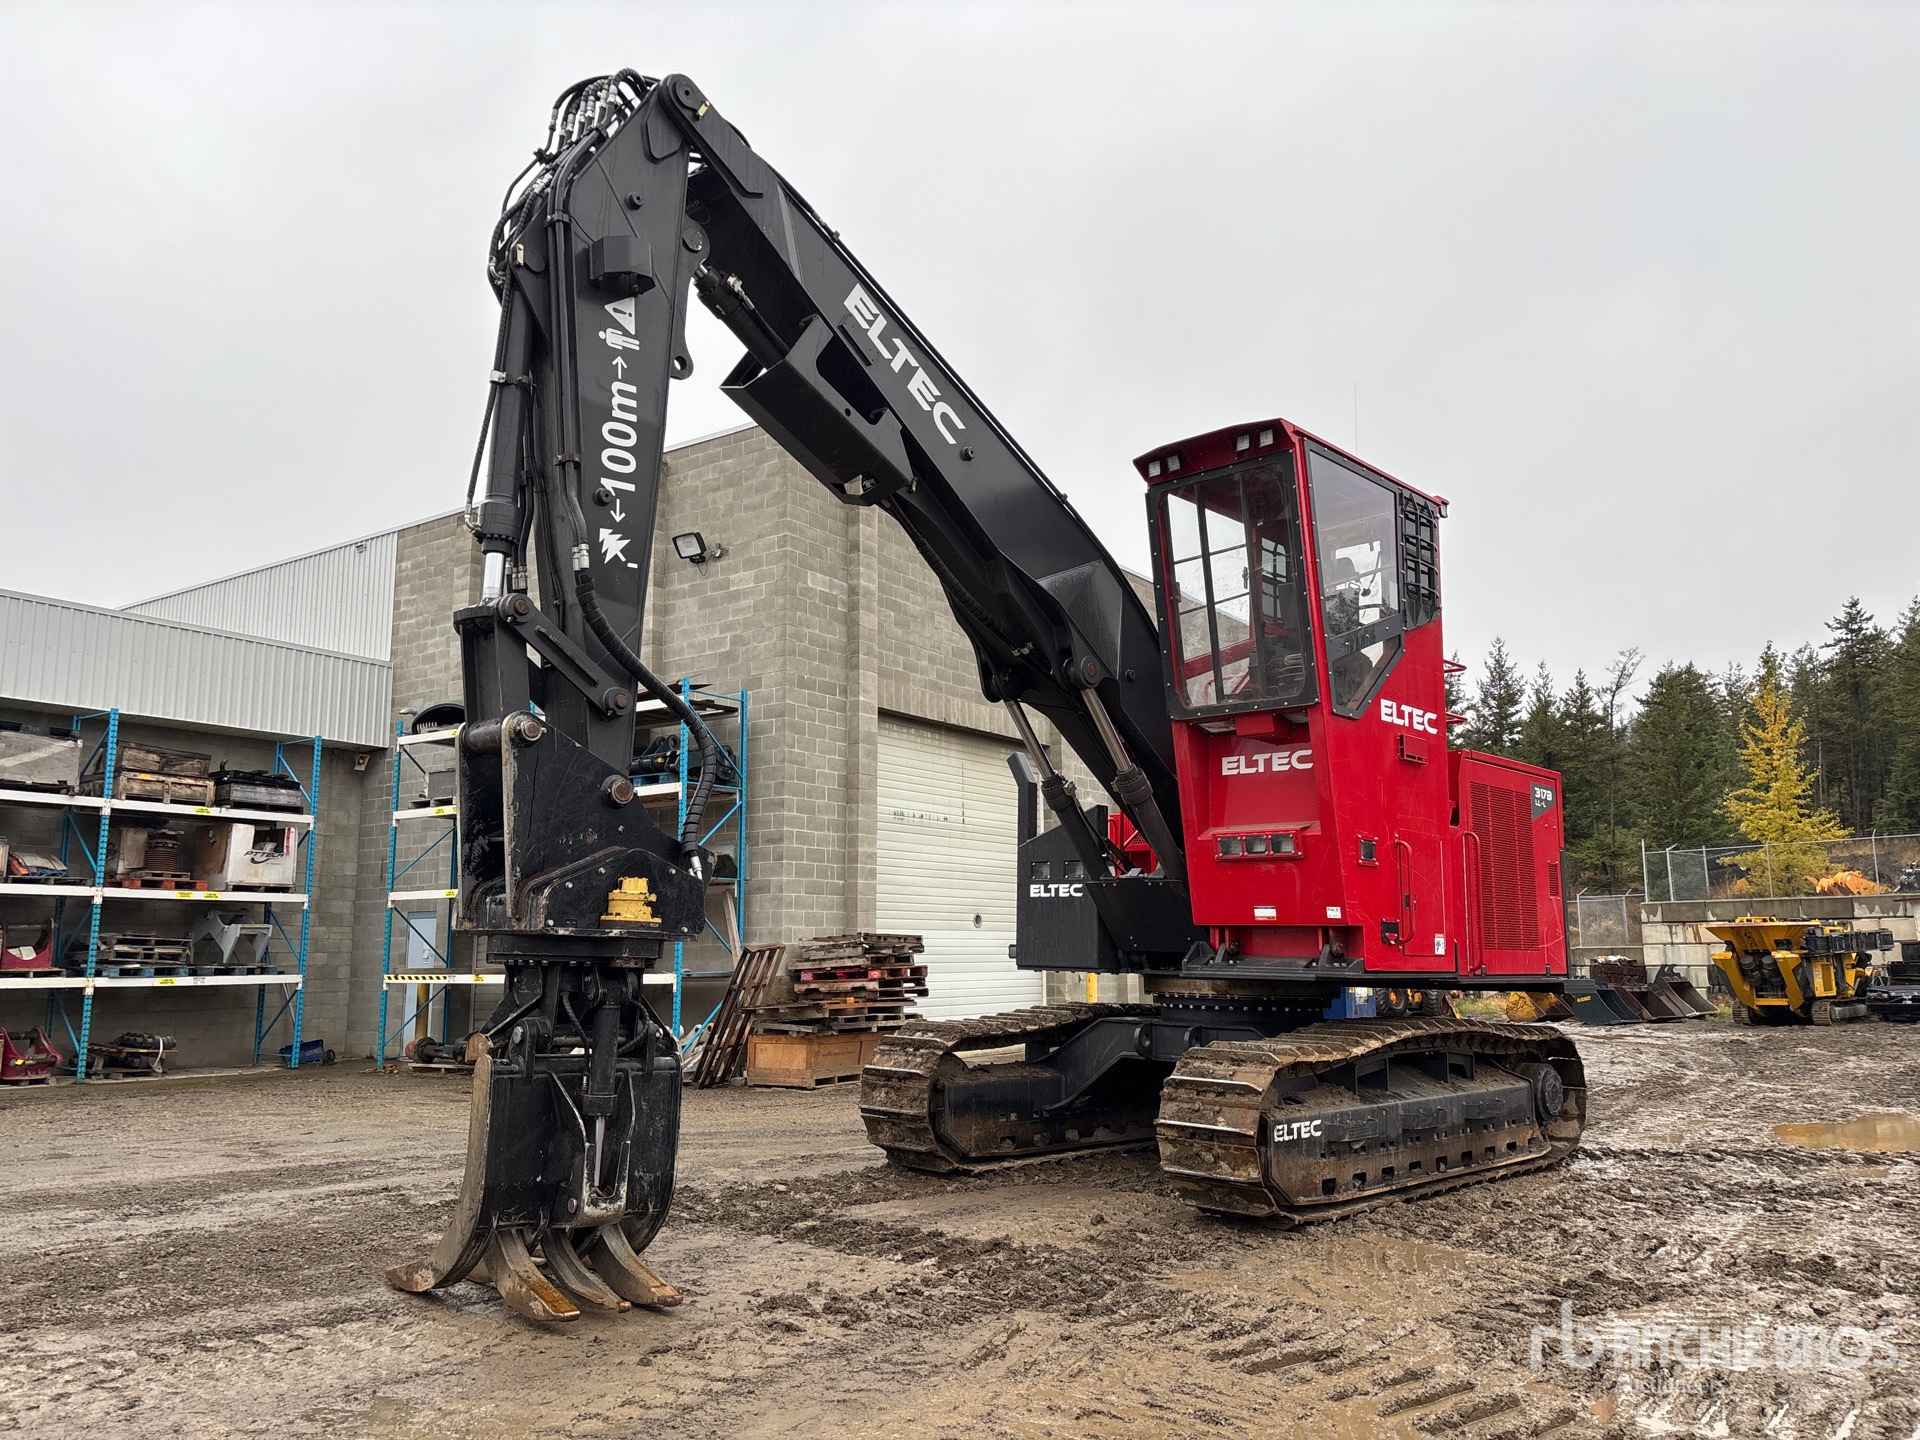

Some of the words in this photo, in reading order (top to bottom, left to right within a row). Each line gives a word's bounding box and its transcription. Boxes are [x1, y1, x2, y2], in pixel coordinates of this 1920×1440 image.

[843, 283, 966, 445] ELTEC
[601, 381, 638, 497] 100m
[1380, 698, 1438, 735] ELTEC
[1221, 749, 1314, 776] ELTEC
[1029, 883, 1084, 898] ELTEC
[1273, 1119, 1322, 1142] ELTEC
